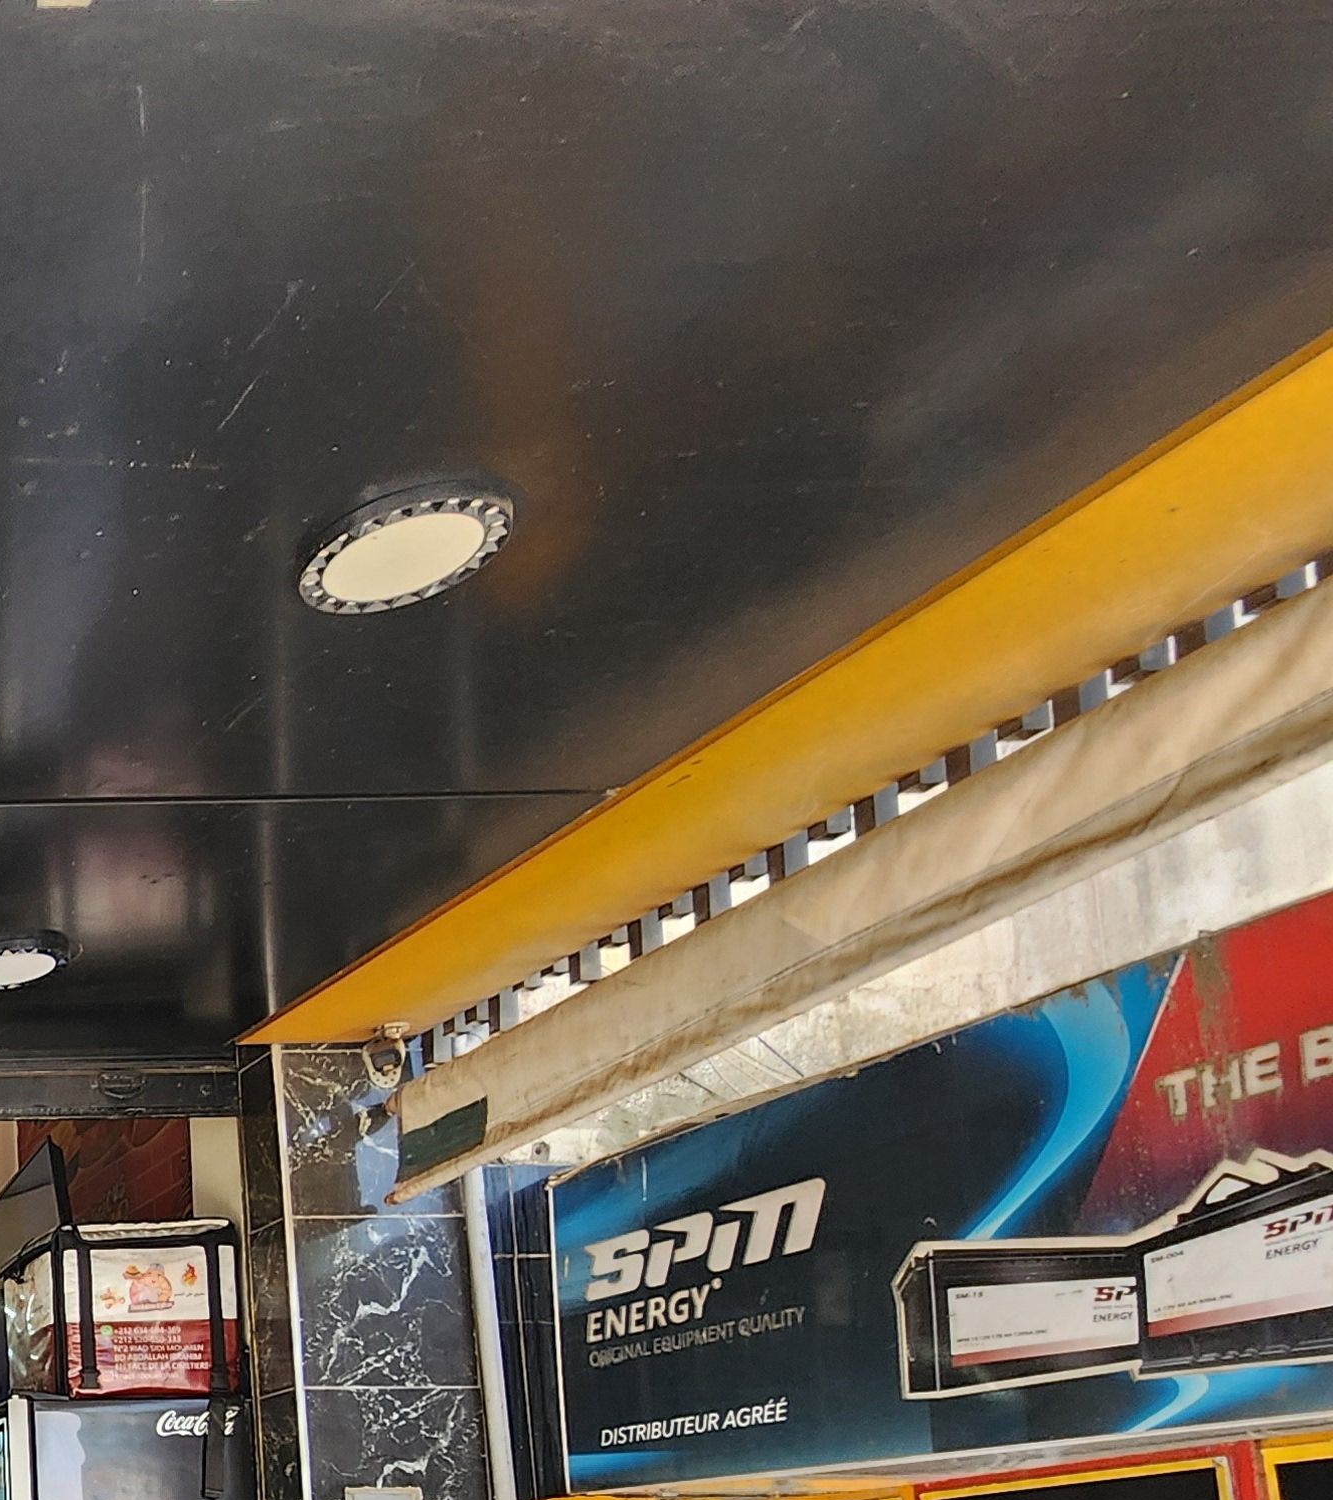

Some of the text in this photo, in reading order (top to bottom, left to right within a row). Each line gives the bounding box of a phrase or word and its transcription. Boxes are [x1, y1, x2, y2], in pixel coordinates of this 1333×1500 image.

[1156, 1041, 1283, 1118] THE
[1265, 1238, 1320, 1260] ENERGY
[586, 1283, 712, 1344] ENERGY
[589, 1306, 806, 1369] ORIGINAL EQUIPMENT QUALITY
[1092, 1310, 1134, 1324] ENERGY
[600, 1396, 789, 1447] DISTRIBUTEUR AGRÉÉ
